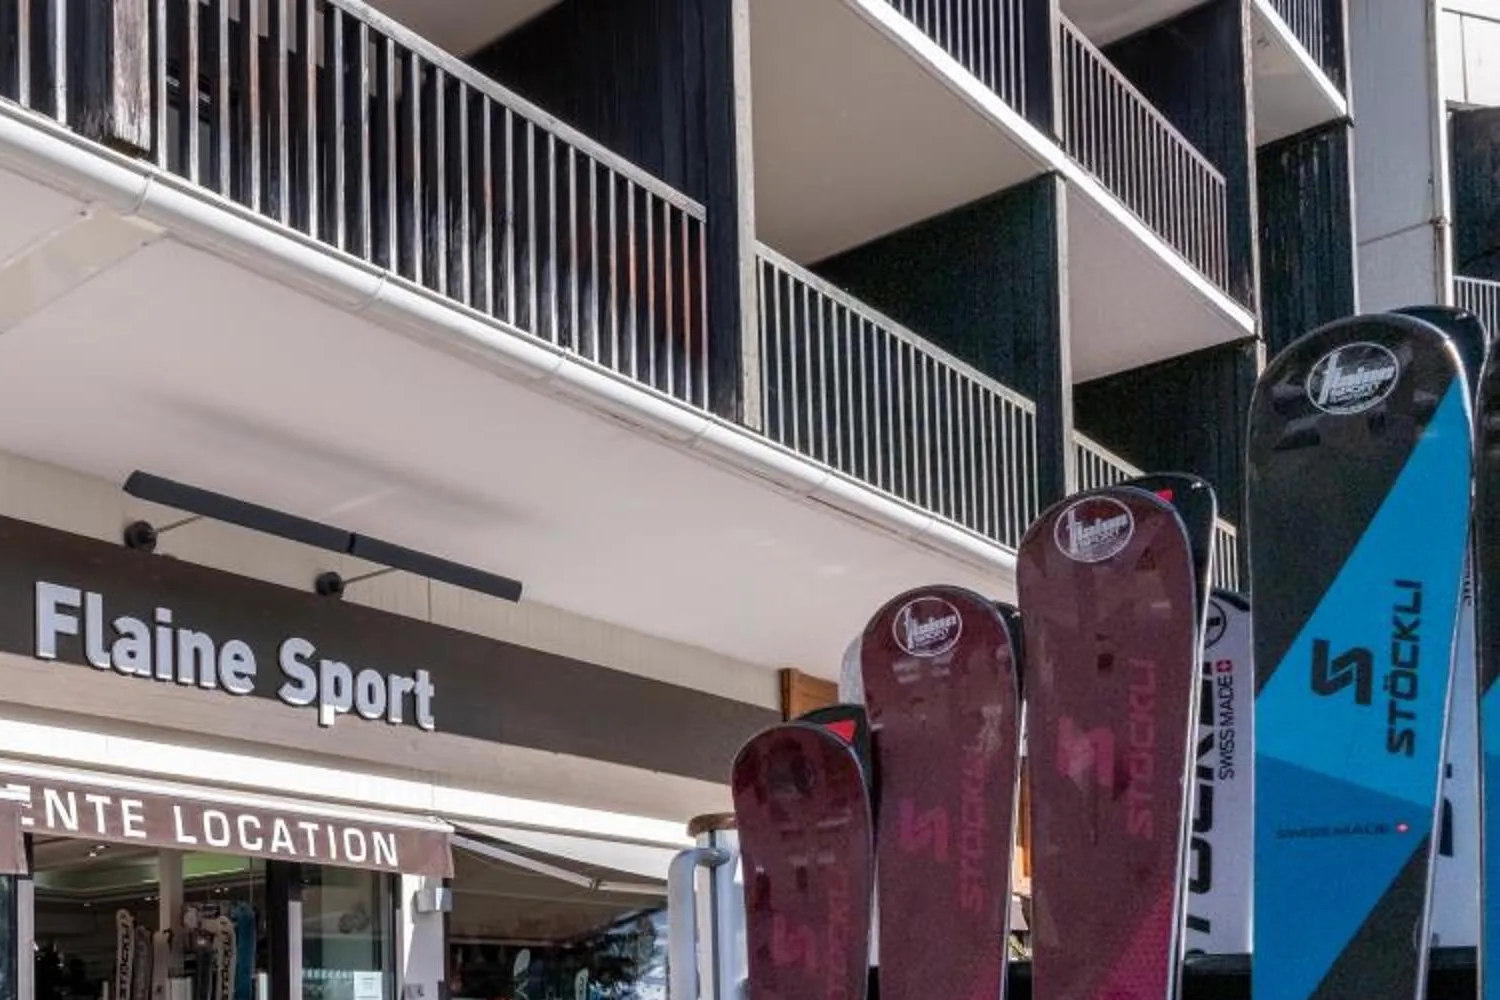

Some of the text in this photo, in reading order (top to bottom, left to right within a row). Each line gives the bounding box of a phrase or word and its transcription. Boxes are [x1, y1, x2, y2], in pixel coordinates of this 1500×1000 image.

[35, 580, 435, 731] Flaine Sport
[1383, 578, 1422, 758] STÖCKLI
[1218, 675, 1235, 780] SWISS MADE
[3, 783, 399, 867] ENTE LOCATION
